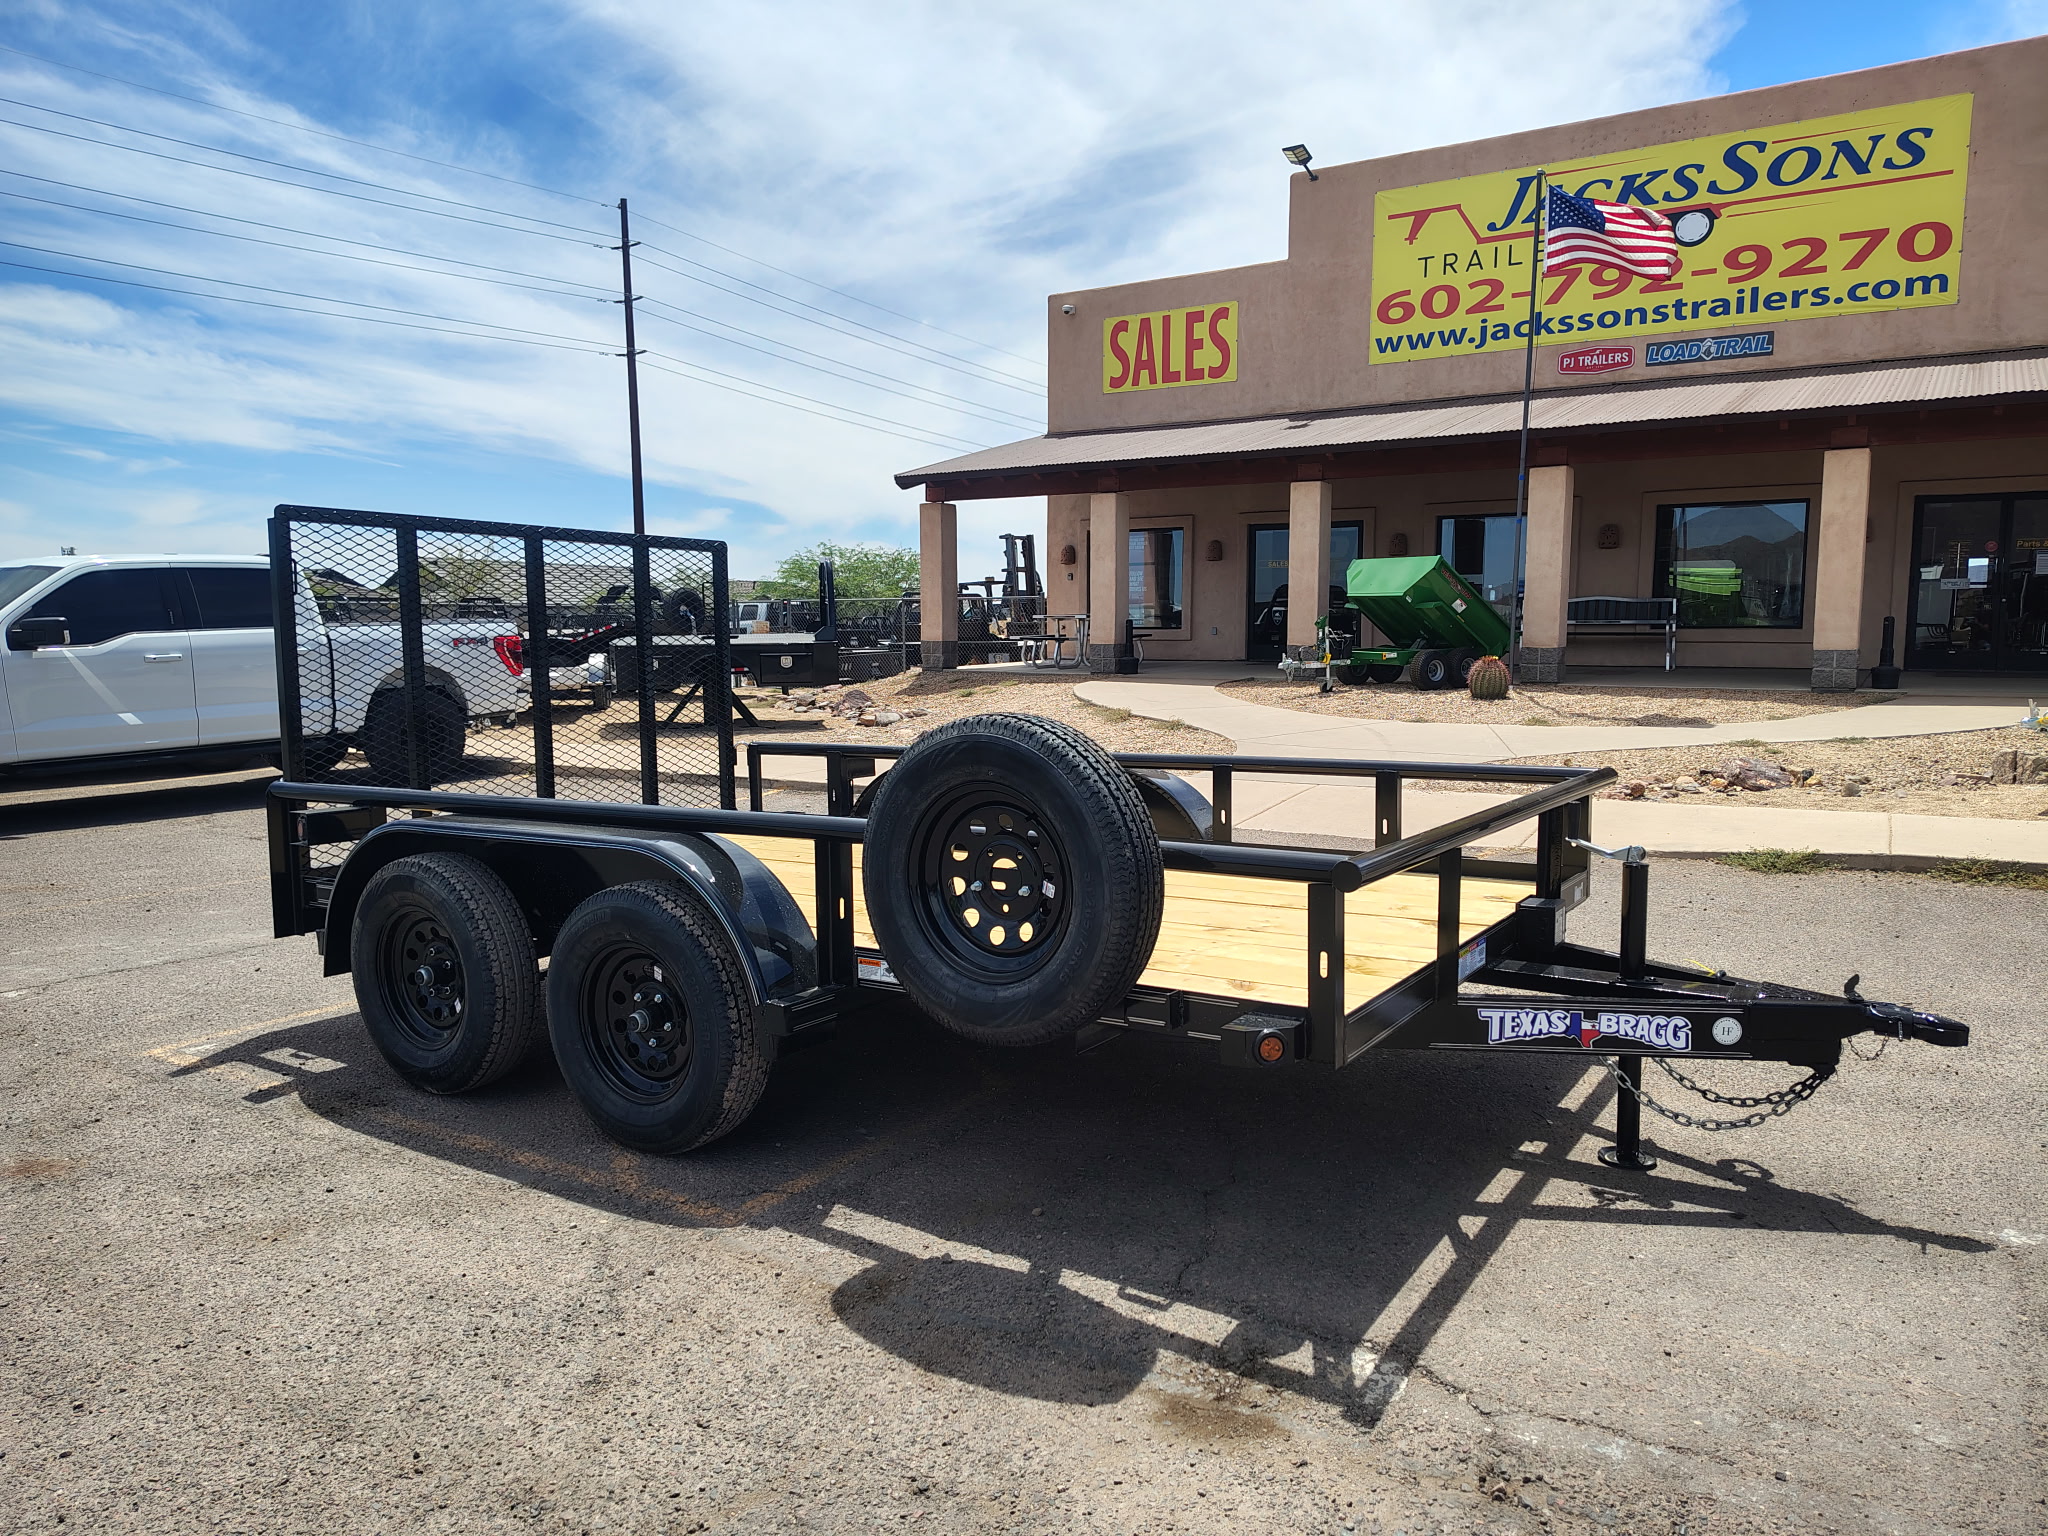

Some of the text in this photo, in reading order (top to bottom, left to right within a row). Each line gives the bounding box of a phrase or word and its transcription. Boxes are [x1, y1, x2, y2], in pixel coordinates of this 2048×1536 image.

[1487, 127, 1933, 232] JCKSSONS
[1376, 221, 1953, 325] 602-792-9270
[1375, 273, 1948, 354] www.jackssonstrailers.com
[1109, 306, 1231, 389] SALES
[1563, 351, 1629, 369] PJ TRAILERS
[1647, 335, 1772, 363] LOAD TRAIL
[1267, 560, 1288, 568] SALES
[1477, 1008, 1692, 1051] TEXAS BRAGG
